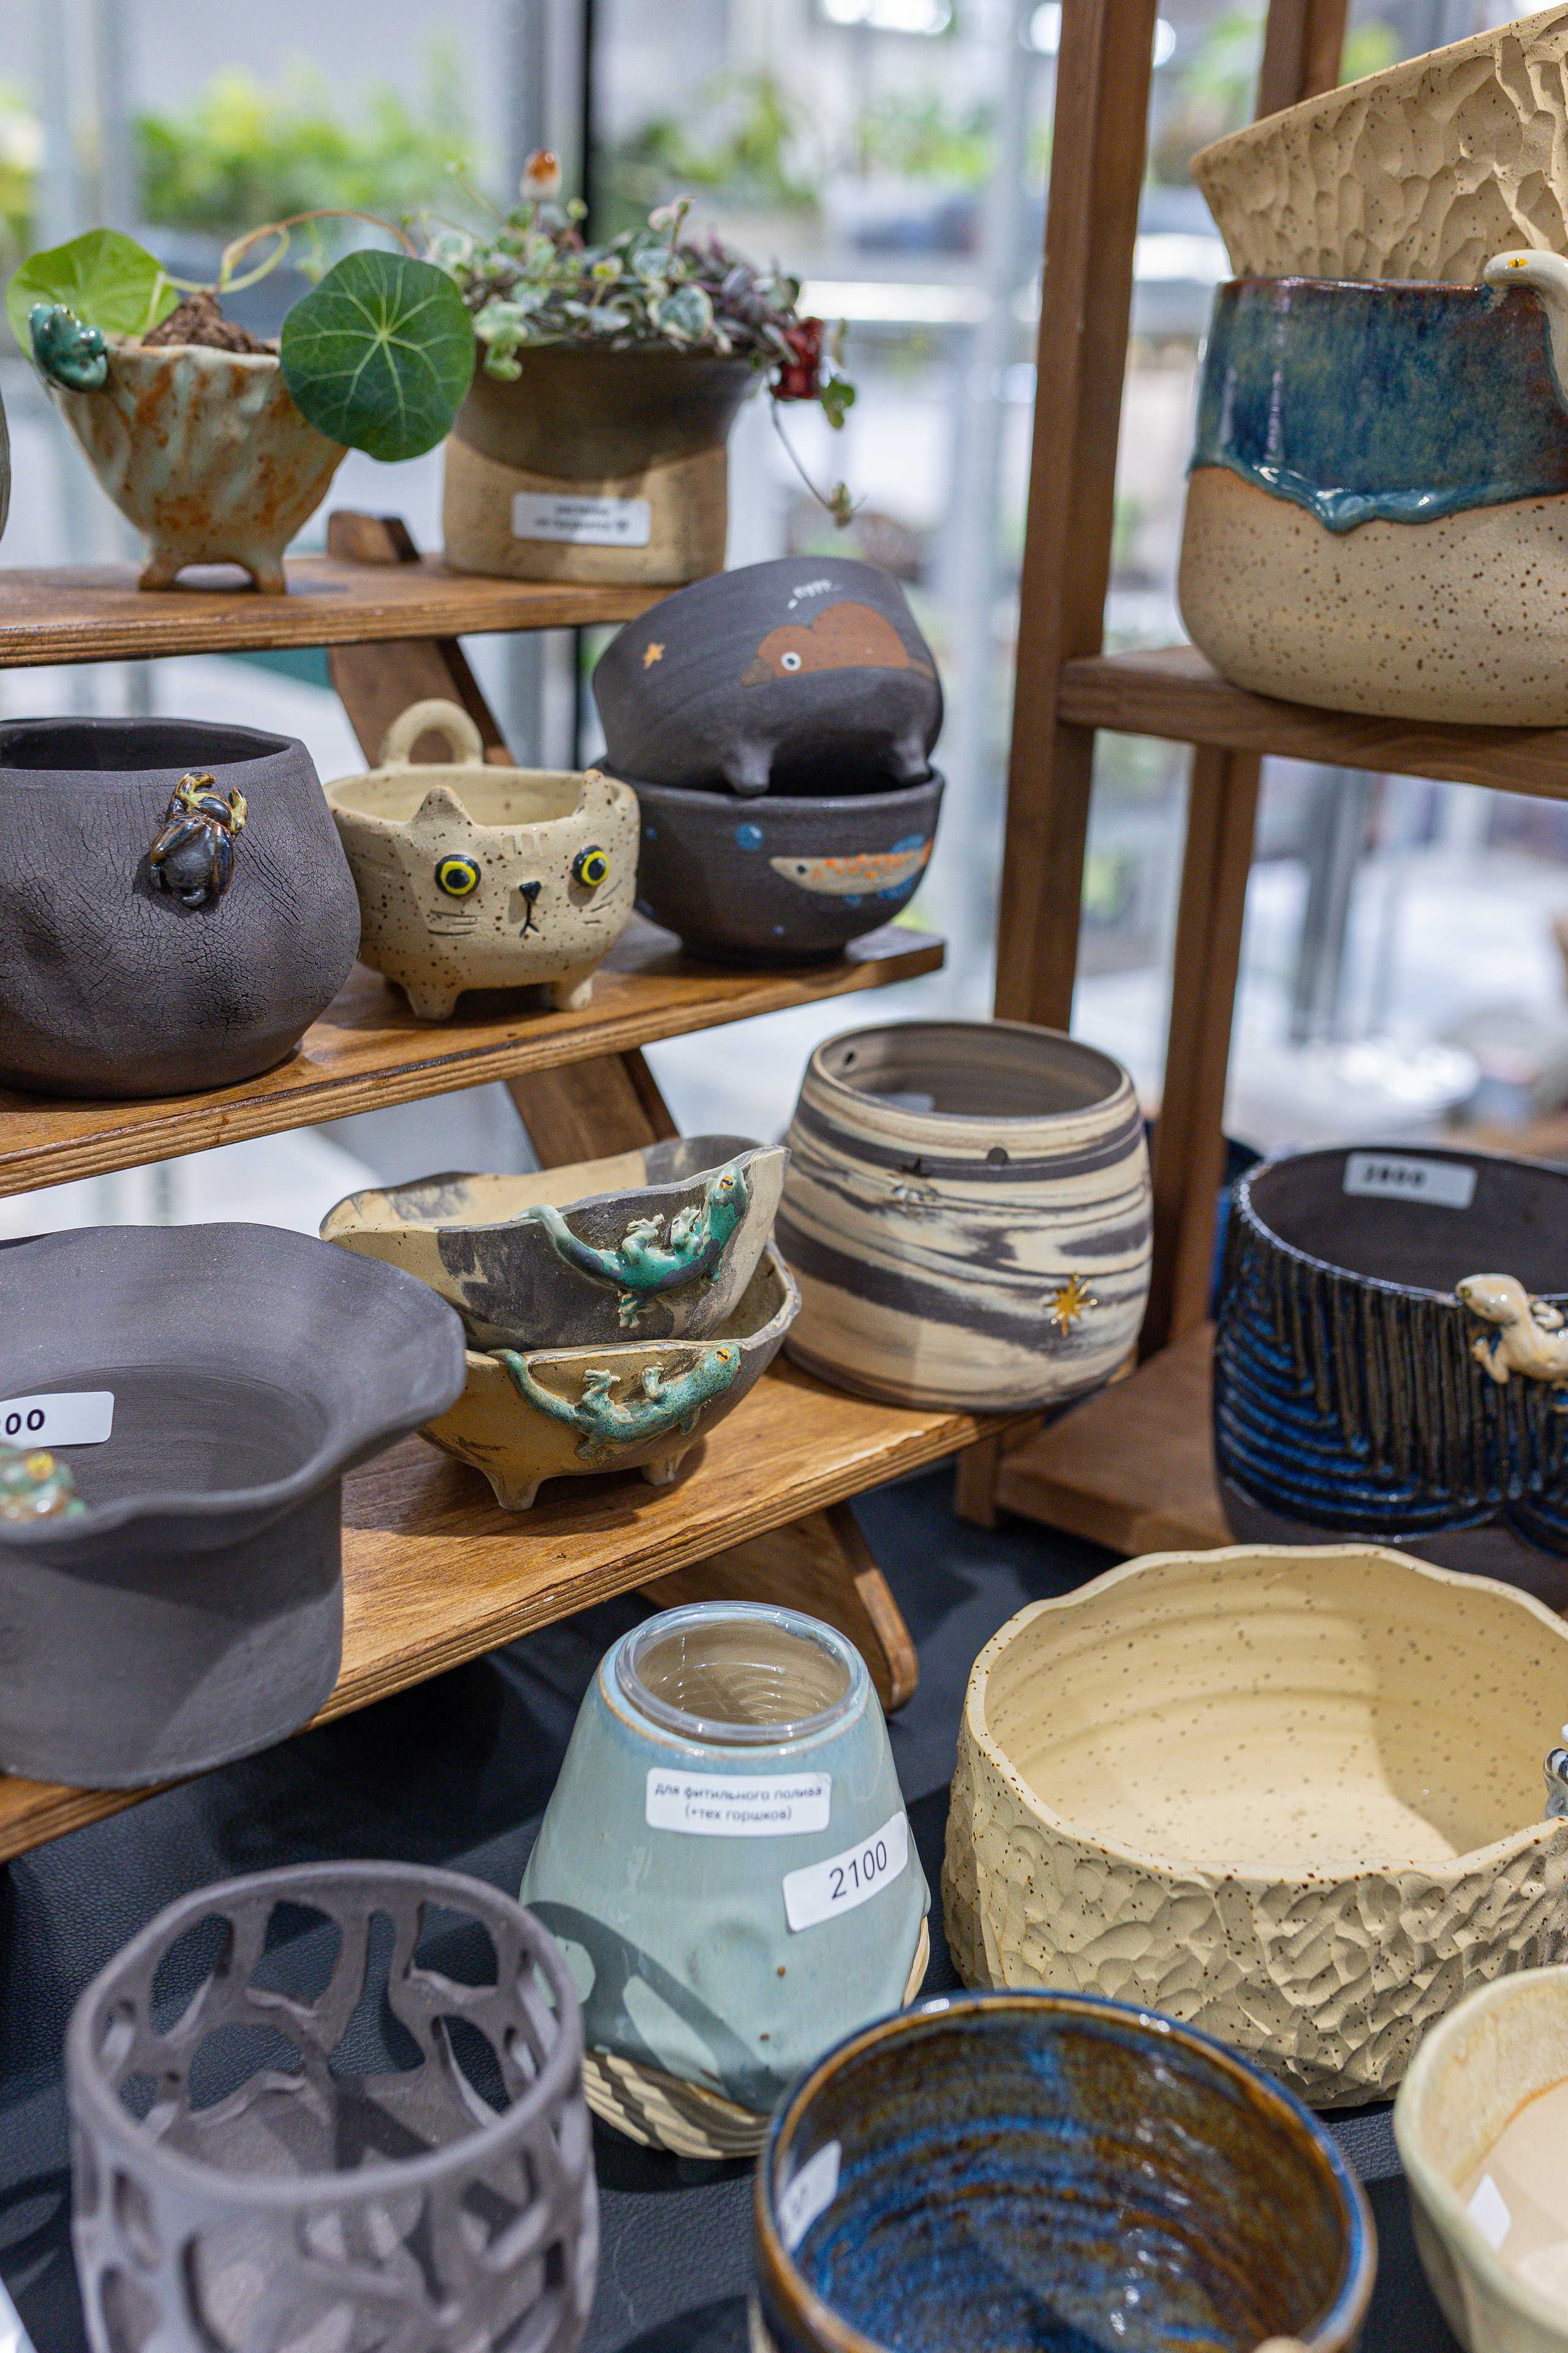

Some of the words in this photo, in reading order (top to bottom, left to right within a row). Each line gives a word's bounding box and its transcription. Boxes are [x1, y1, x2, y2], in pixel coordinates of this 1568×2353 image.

[0, 1408, 45, 1435] 00
[684, 1786, 770, 1802] фитильного
[774, 1786, 822, 1800] полива
[726, 1805, 792, 1823] горшков)
[829, 1840, 887, 1900] 2100
